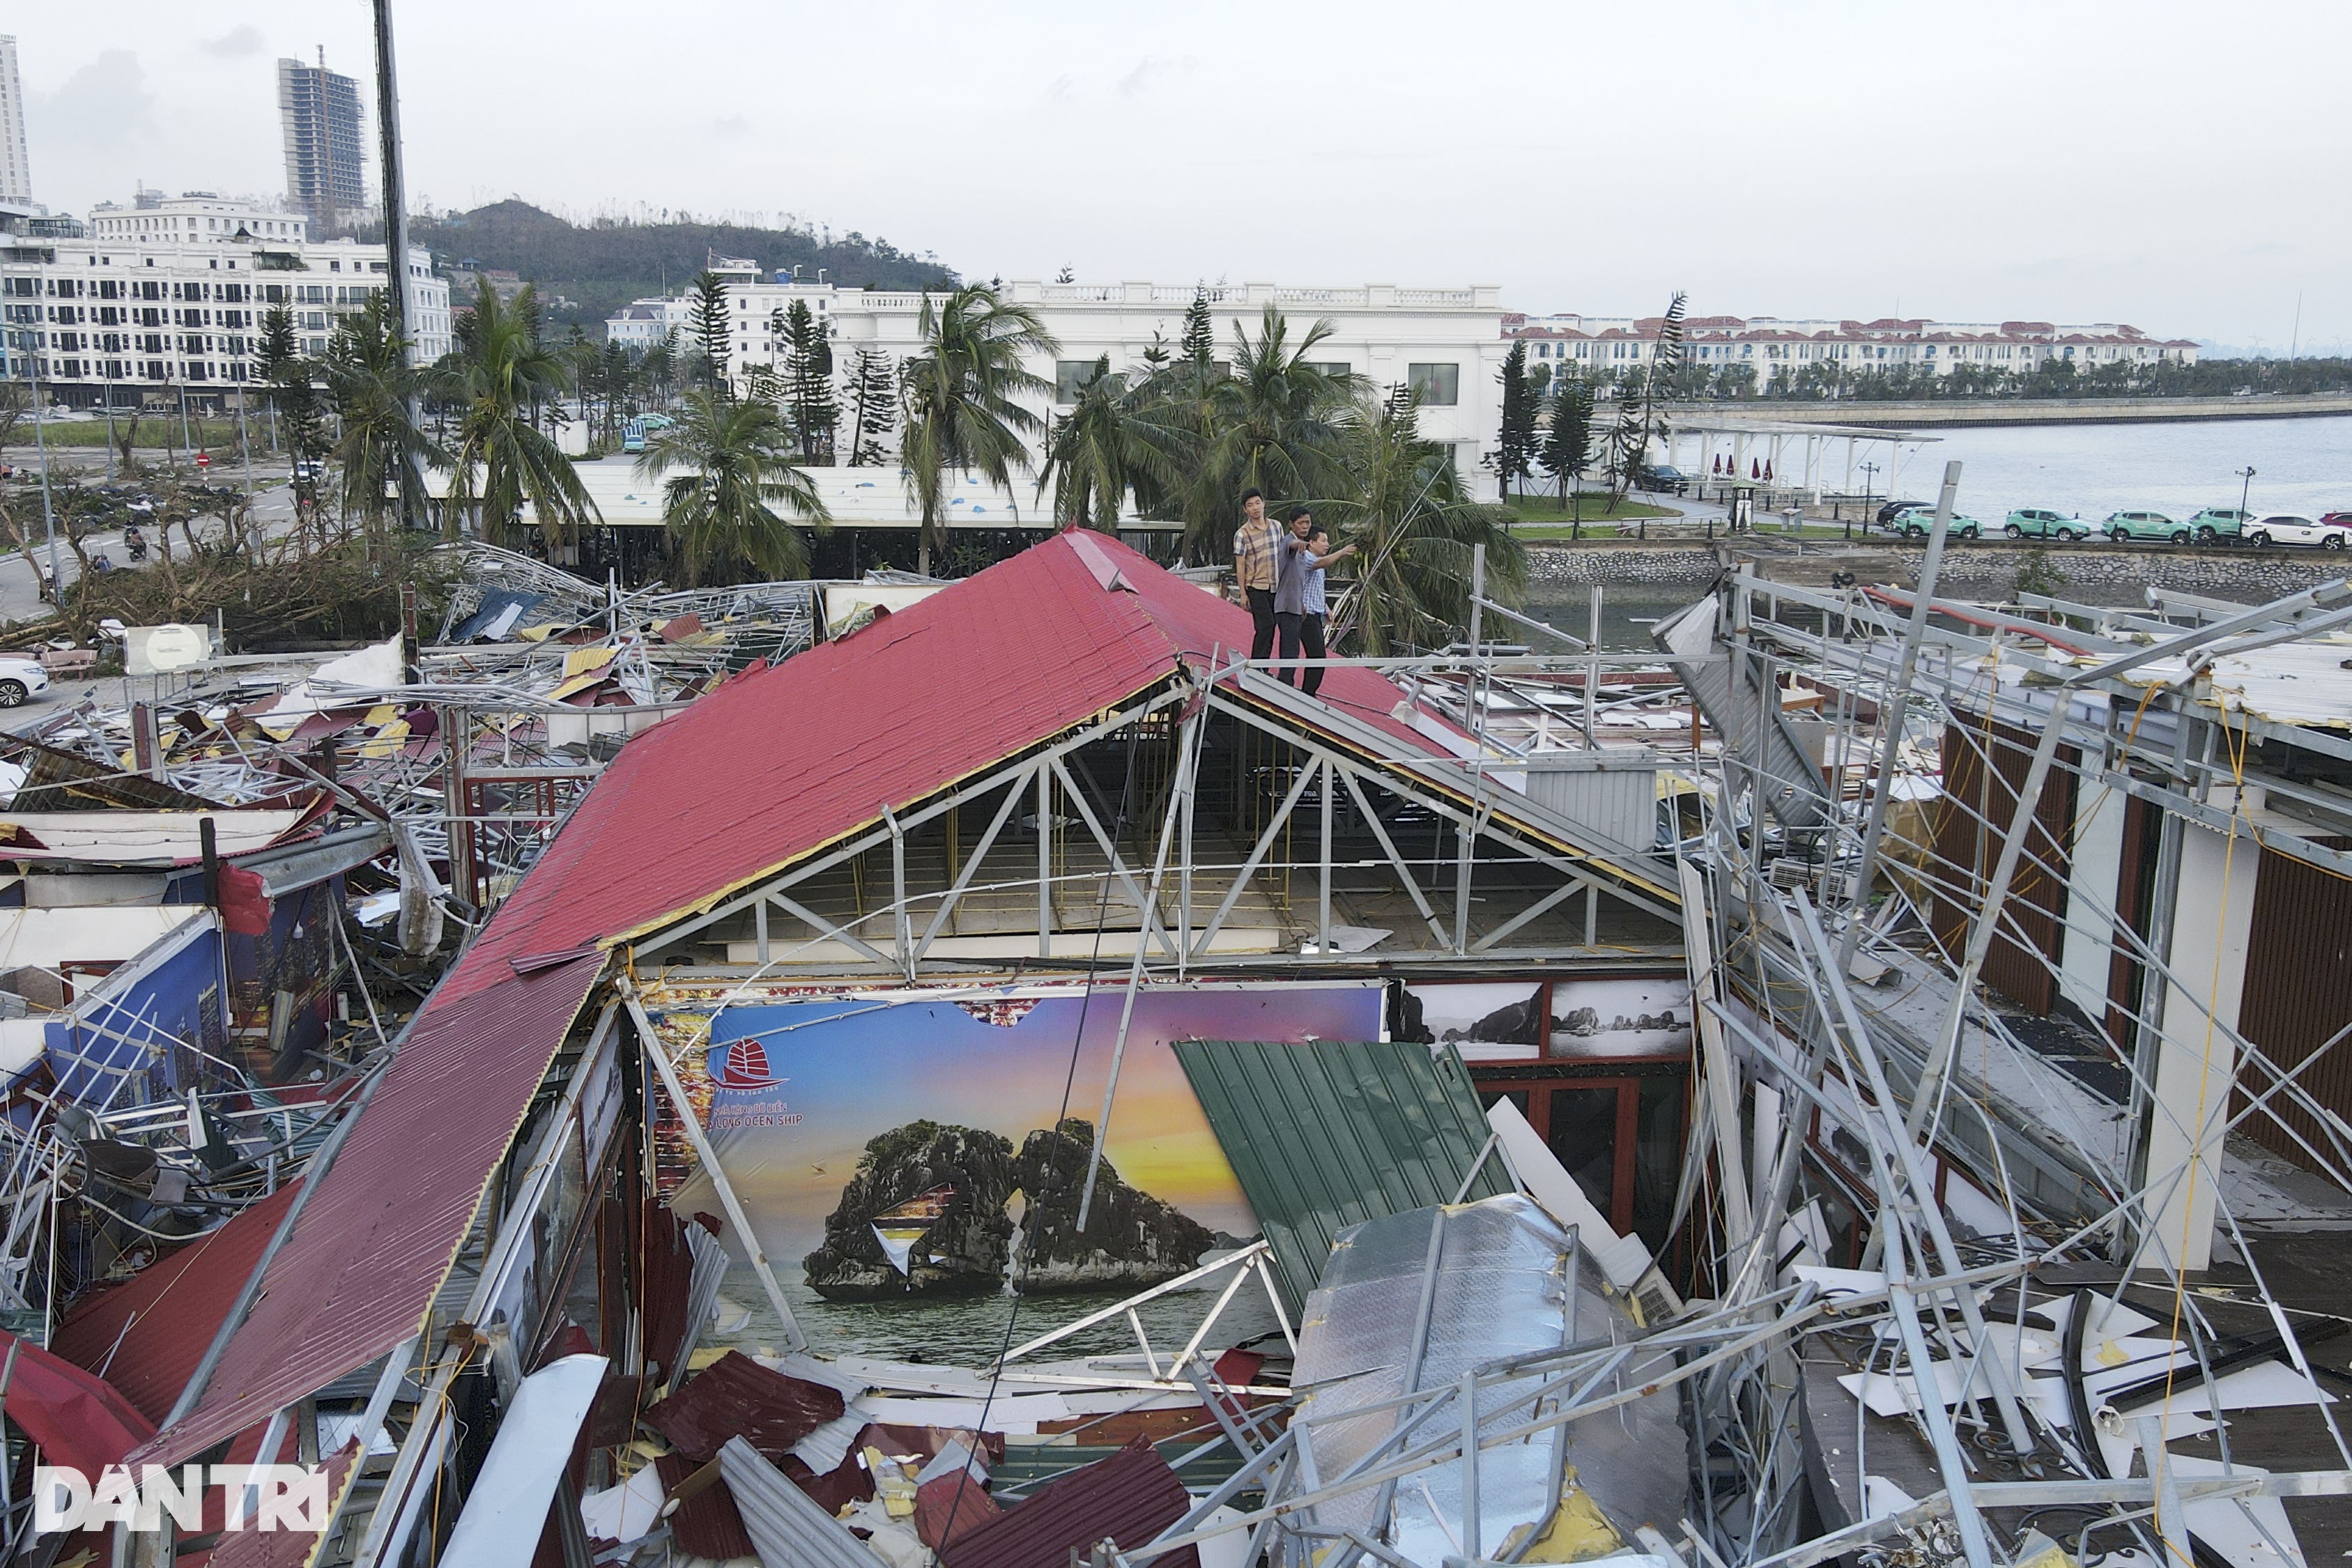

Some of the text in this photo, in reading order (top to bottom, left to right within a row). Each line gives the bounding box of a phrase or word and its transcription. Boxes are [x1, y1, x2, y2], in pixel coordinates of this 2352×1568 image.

[716, 1117, 741, 1129] LONG
[744, 1115, 774, 1127] OCEN
[777, 1114, 804, 1126] SHIP
